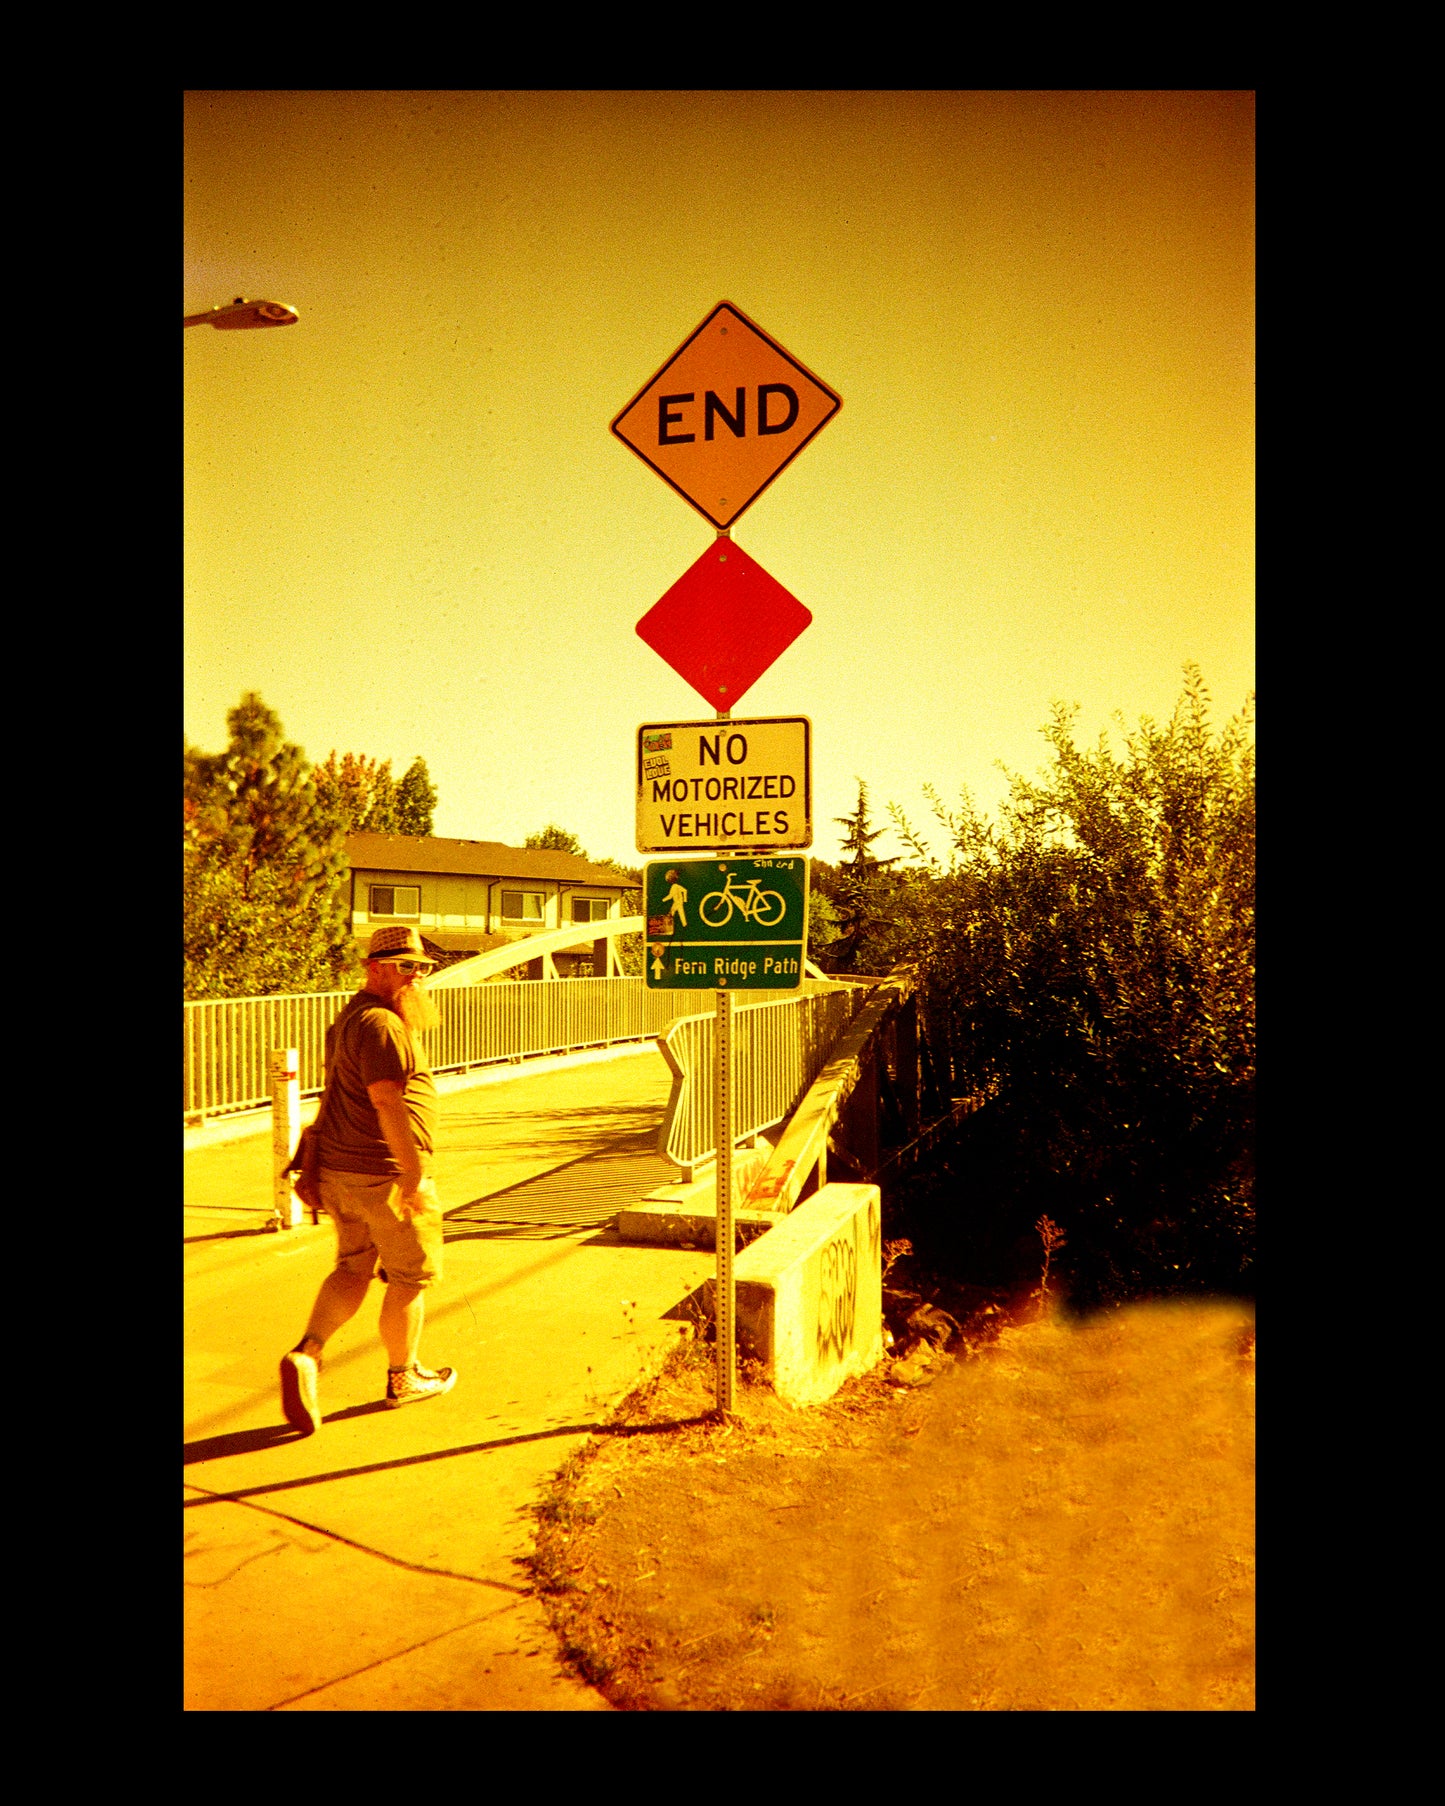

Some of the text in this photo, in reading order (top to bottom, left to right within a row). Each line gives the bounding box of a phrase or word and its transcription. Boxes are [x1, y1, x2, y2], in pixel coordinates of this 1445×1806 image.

[658, 383, 799, 445] END
[700, 733, 748, 766] NO
[653, 775, 796, 802] MOTORIZED
[660, 810, 789, 837] VEHICLES
[675, 957, 798, 979] Fern Ridge Path
